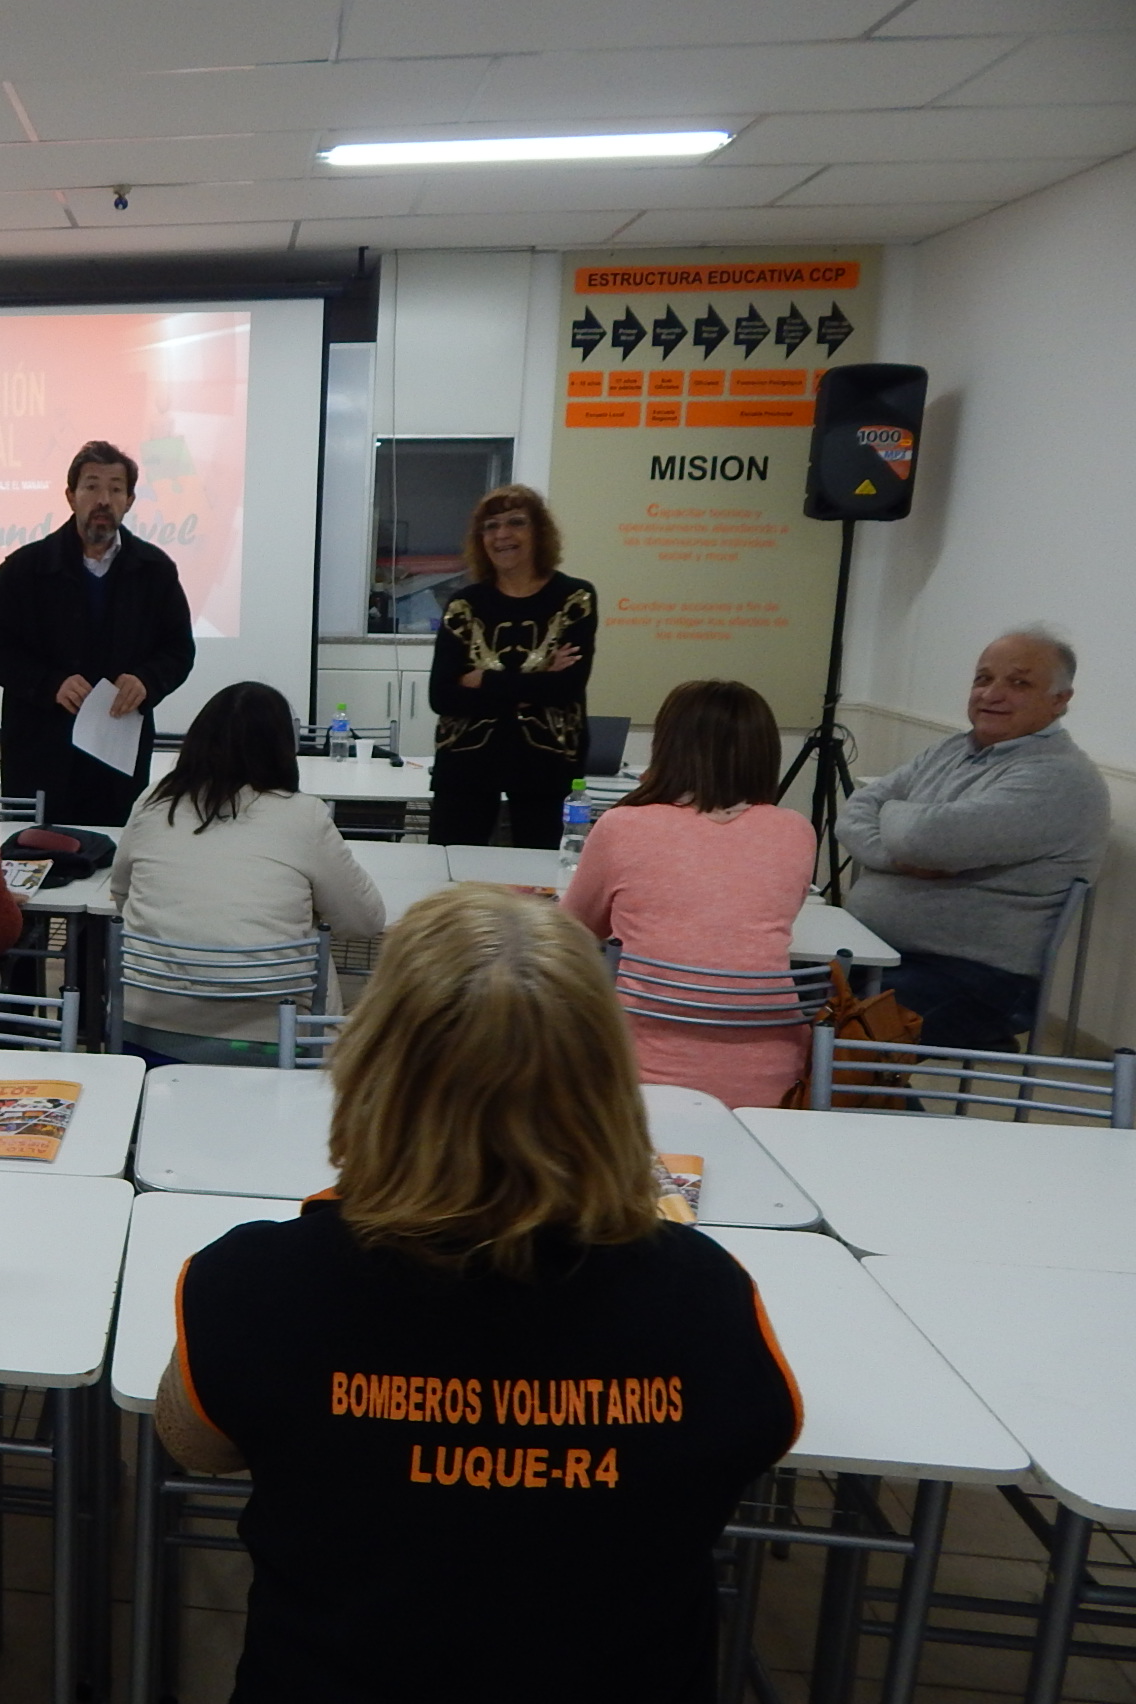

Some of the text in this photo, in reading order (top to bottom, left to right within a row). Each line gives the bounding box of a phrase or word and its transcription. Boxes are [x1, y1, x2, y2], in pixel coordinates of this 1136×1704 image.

[588, 267, 846, 287] ESTRUCTURA EDUCATIVA CCP
[857, 429, 902, 445] 1000
[650, 455, 769, 481] MISION
[130, 513, 199, 546] ivel
[331, 1371, 684, 1426] BOMBEROS VOLUNTARIOS
[409, 1444, 619, 1490] LUQUE-R4
